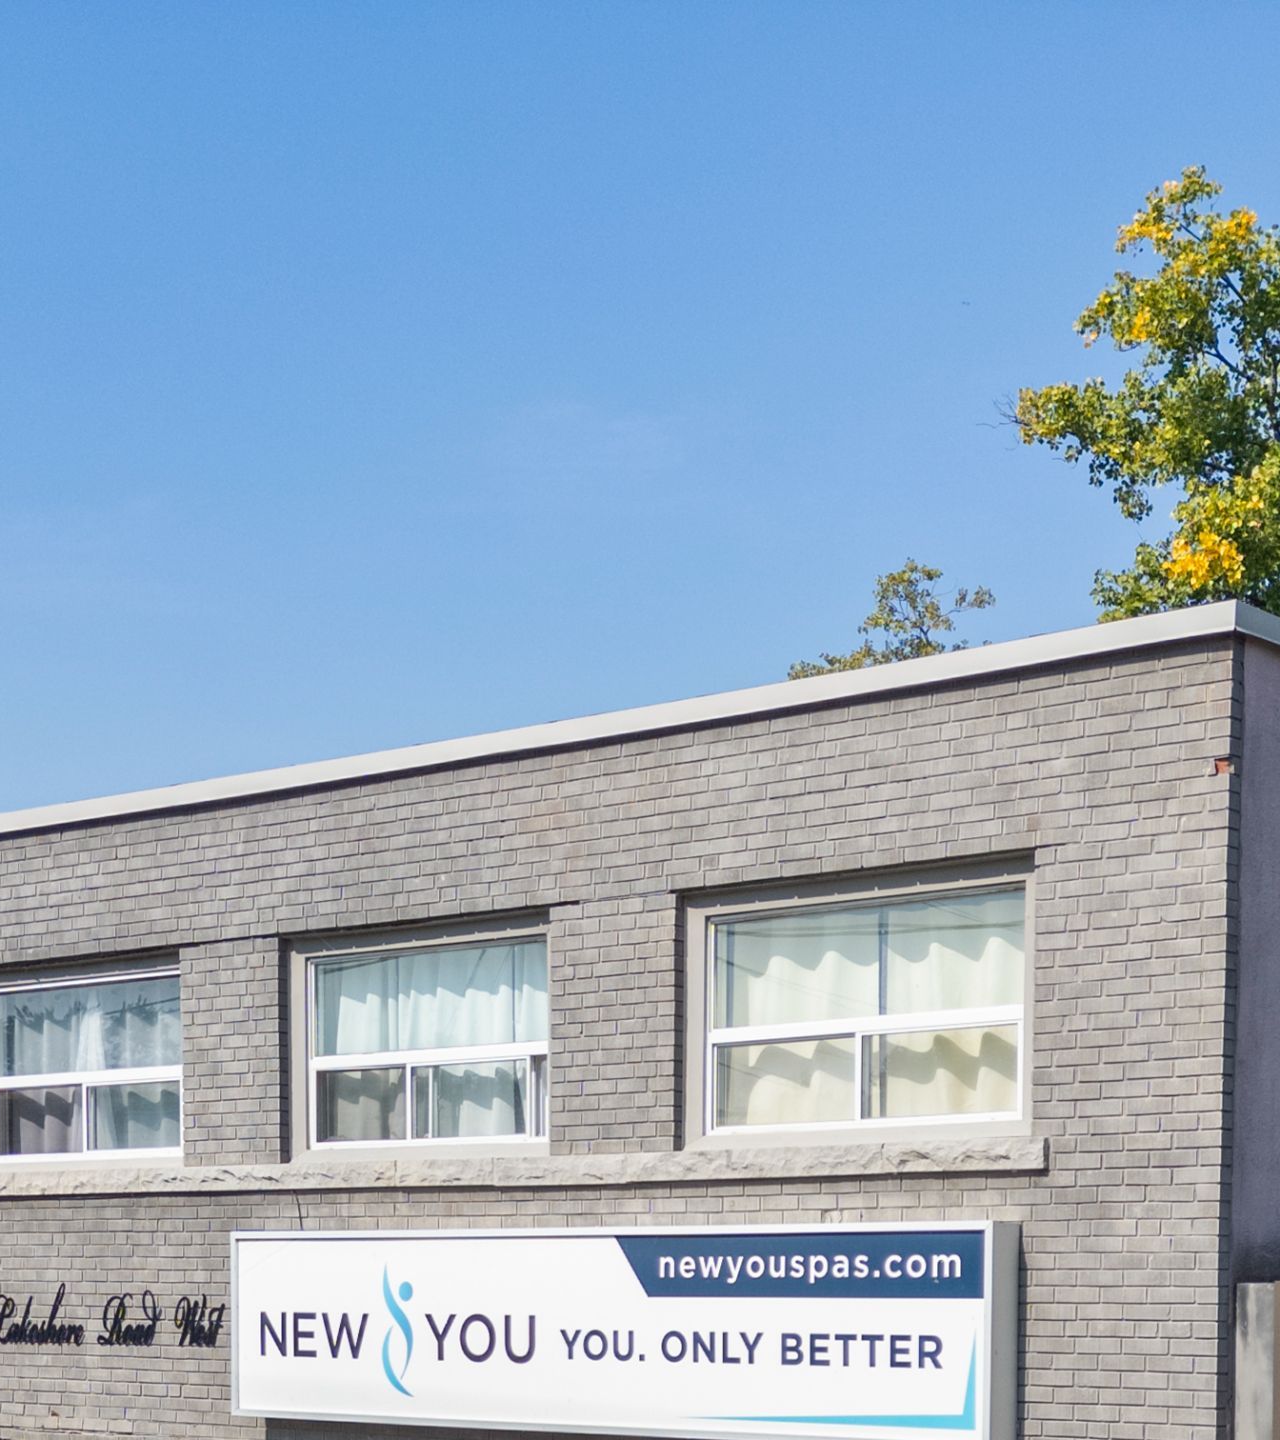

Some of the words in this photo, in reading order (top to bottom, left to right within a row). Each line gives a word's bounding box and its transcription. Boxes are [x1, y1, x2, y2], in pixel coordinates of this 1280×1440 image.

[658, 1251, 962, 1284] newyouspas.com
[97, 1290, 162, 1346] Road
[175, 1294, 225, 1347] West
[260, 1311, 369, 1359] NEW
[425, 1314, 537, 1363] YOU
[559, 1328, 646, 1363] YOU.
[660, 1330, 764, 1365] ONLY
[781, 1334, 944, 1369] BETTER
